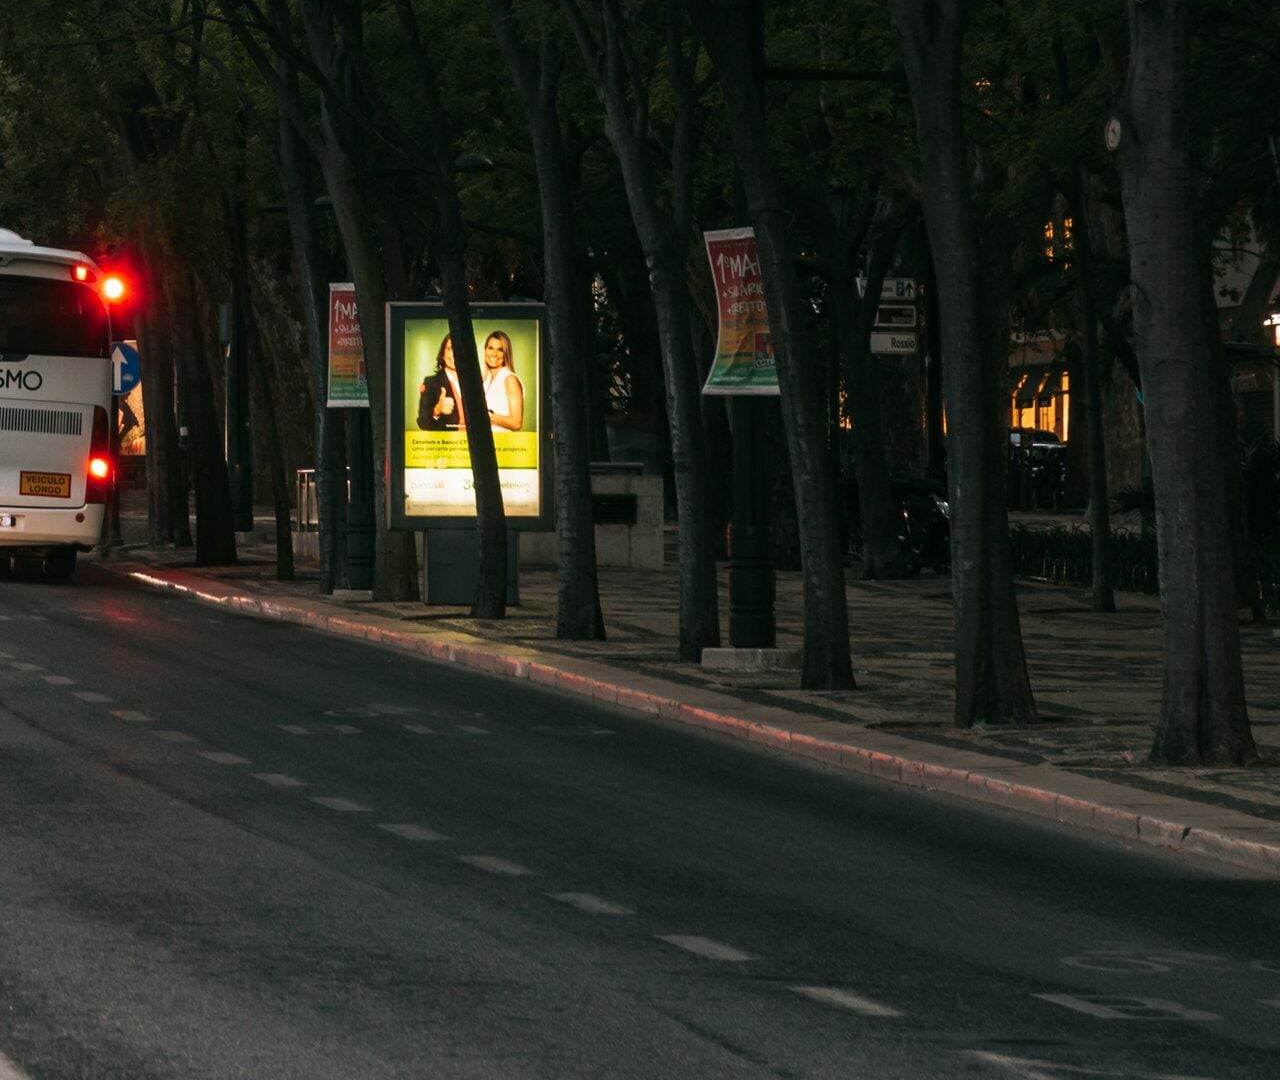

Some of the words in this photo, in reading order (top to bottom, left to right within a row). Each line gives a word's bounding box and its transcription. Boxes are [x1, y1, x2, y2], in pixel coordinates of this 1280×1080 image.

[730, 252, 762, 279] MAI
[890, 337, 915, 349] Rossio
[29, 485, 61, 494] LONGO
